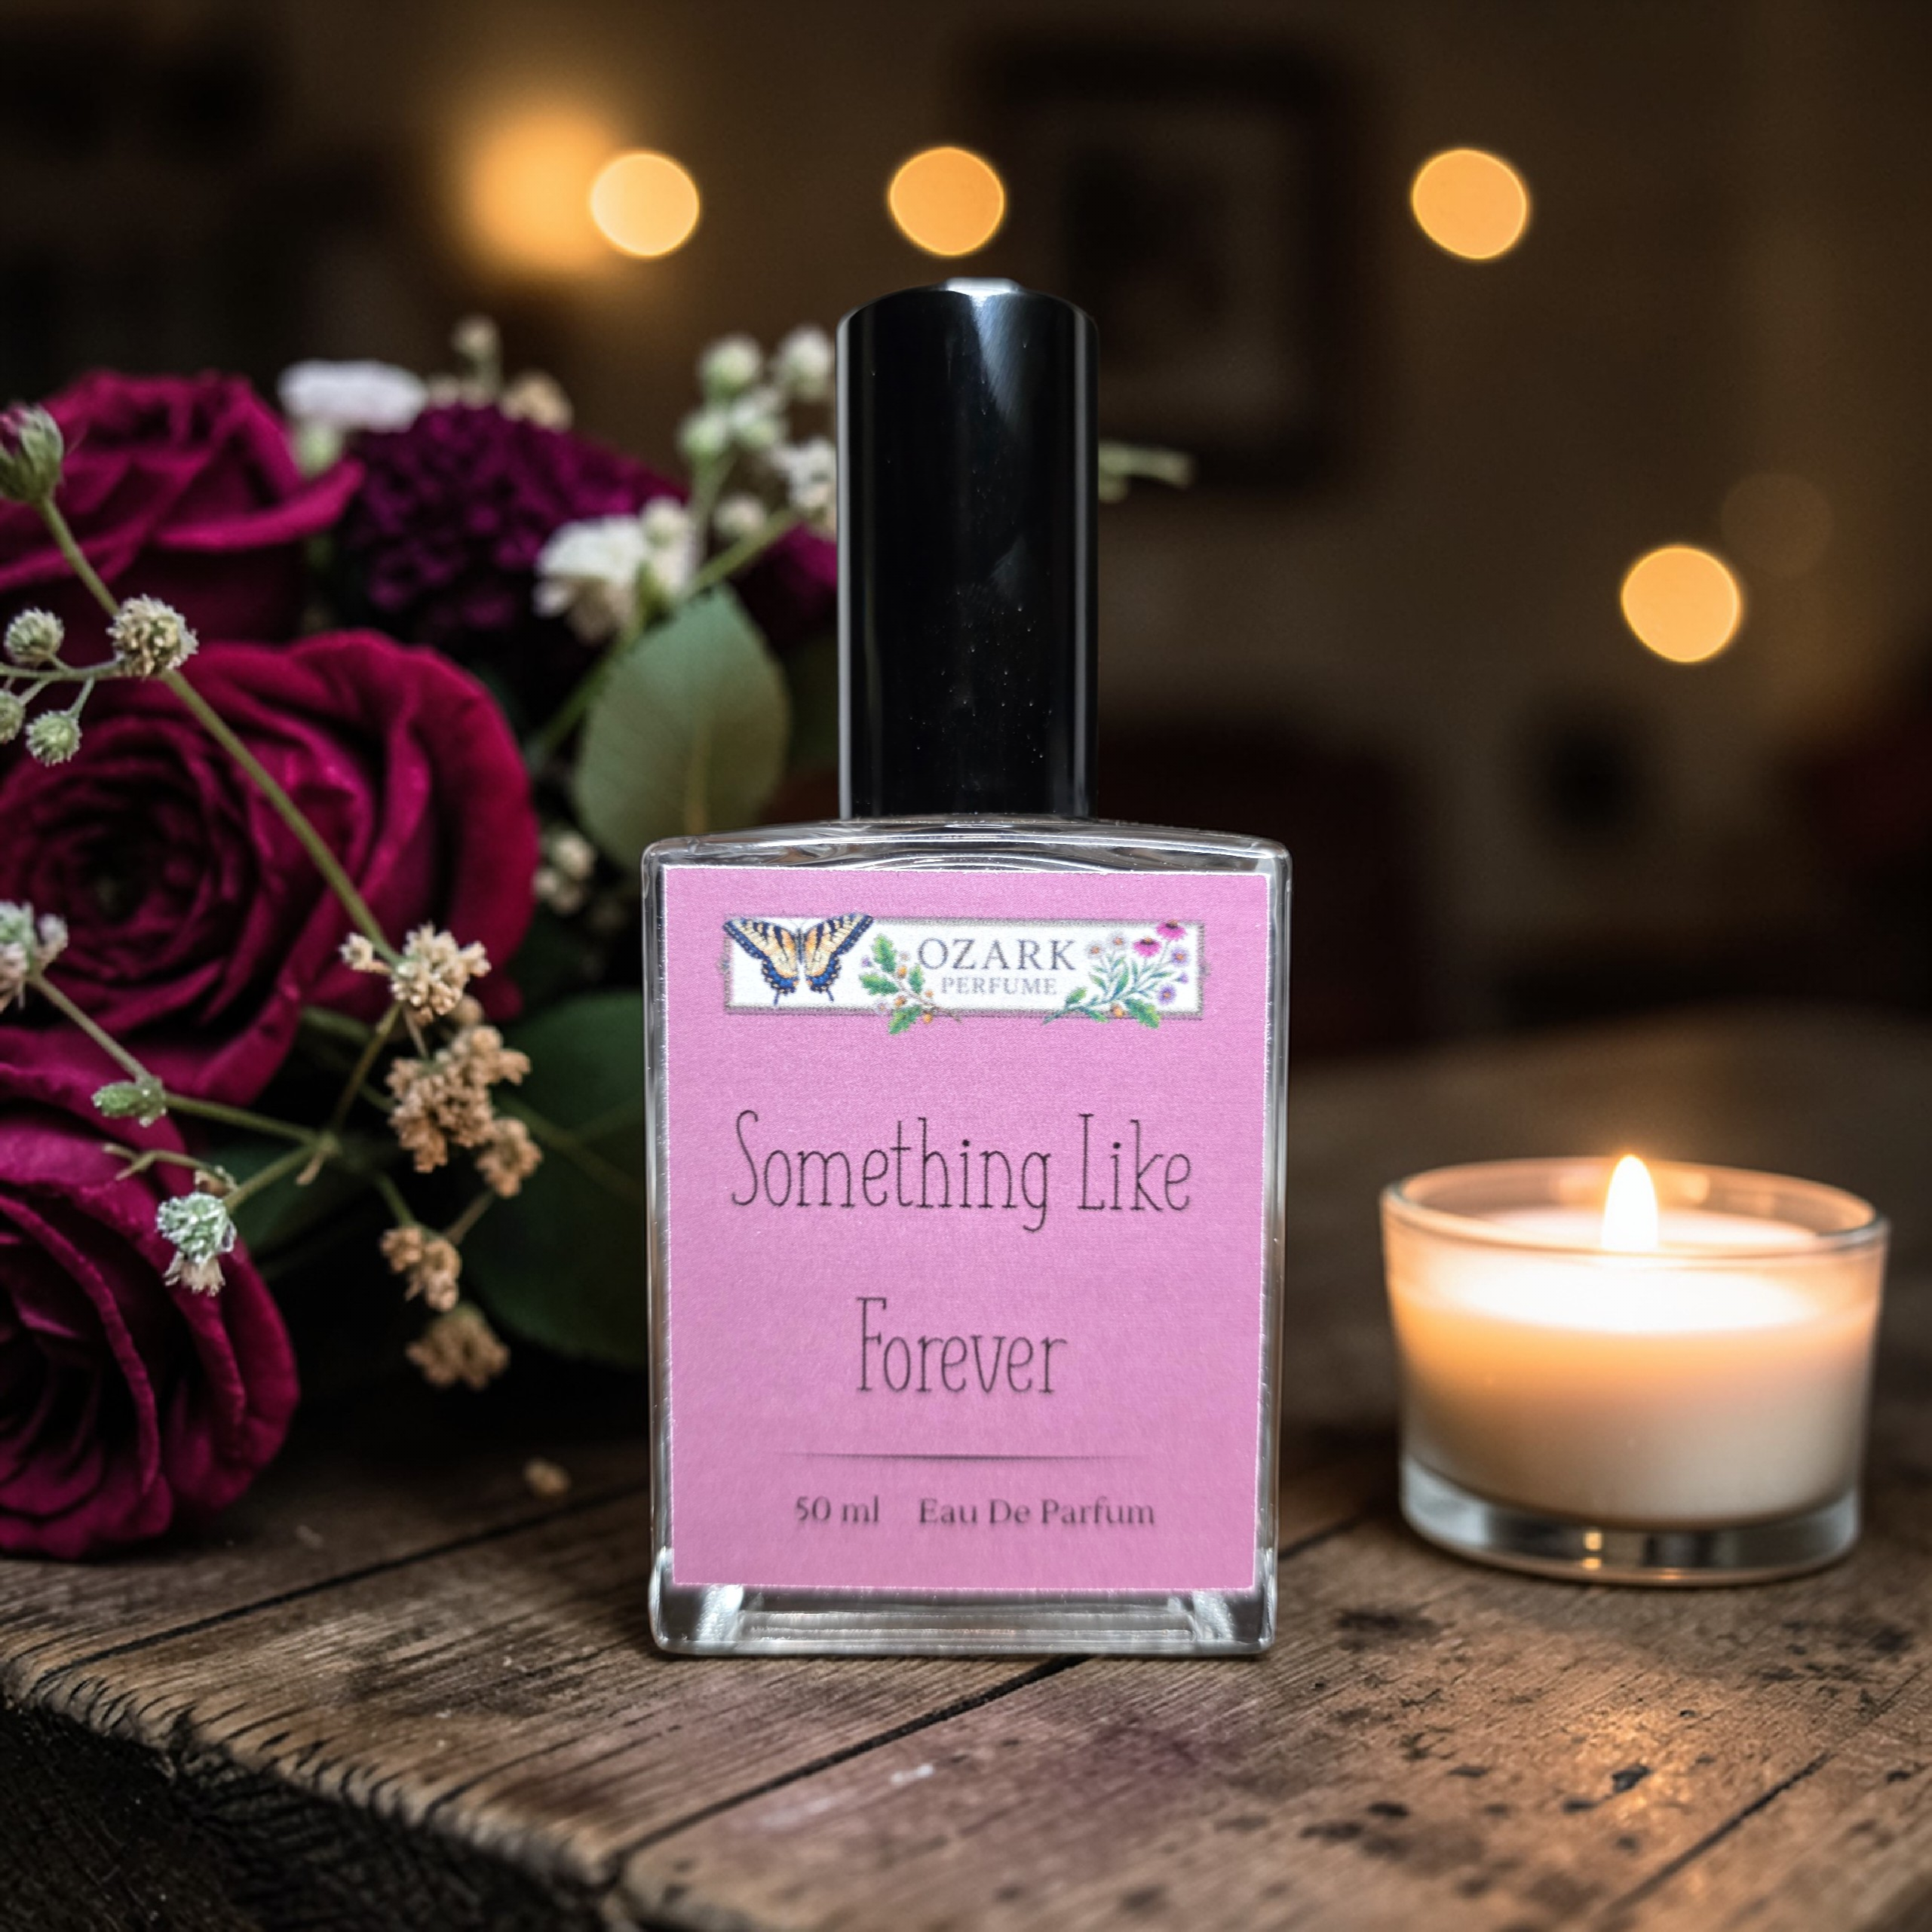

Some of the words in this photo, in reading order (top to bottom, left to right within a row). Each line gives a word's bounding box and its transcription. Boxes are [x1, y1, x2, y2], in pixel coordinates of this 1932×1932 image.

[916, 937, 1078, 971] OZARK
[941, 977, 1058, 995] PERFUME
[731, 1109, 1051, 1233] Something
[1078, 1113, 1192, 1213] Like
[856, 1296, 1068, 1394] Forever
[795, 1495, 831, 1523] 50
[842, 1495, 880, 1524] ml
[919, 1498, 978, 1524] Eau
[989, 1498, 1030, 1524] De
[1041, 1496, 1155, 1526] Parfum
